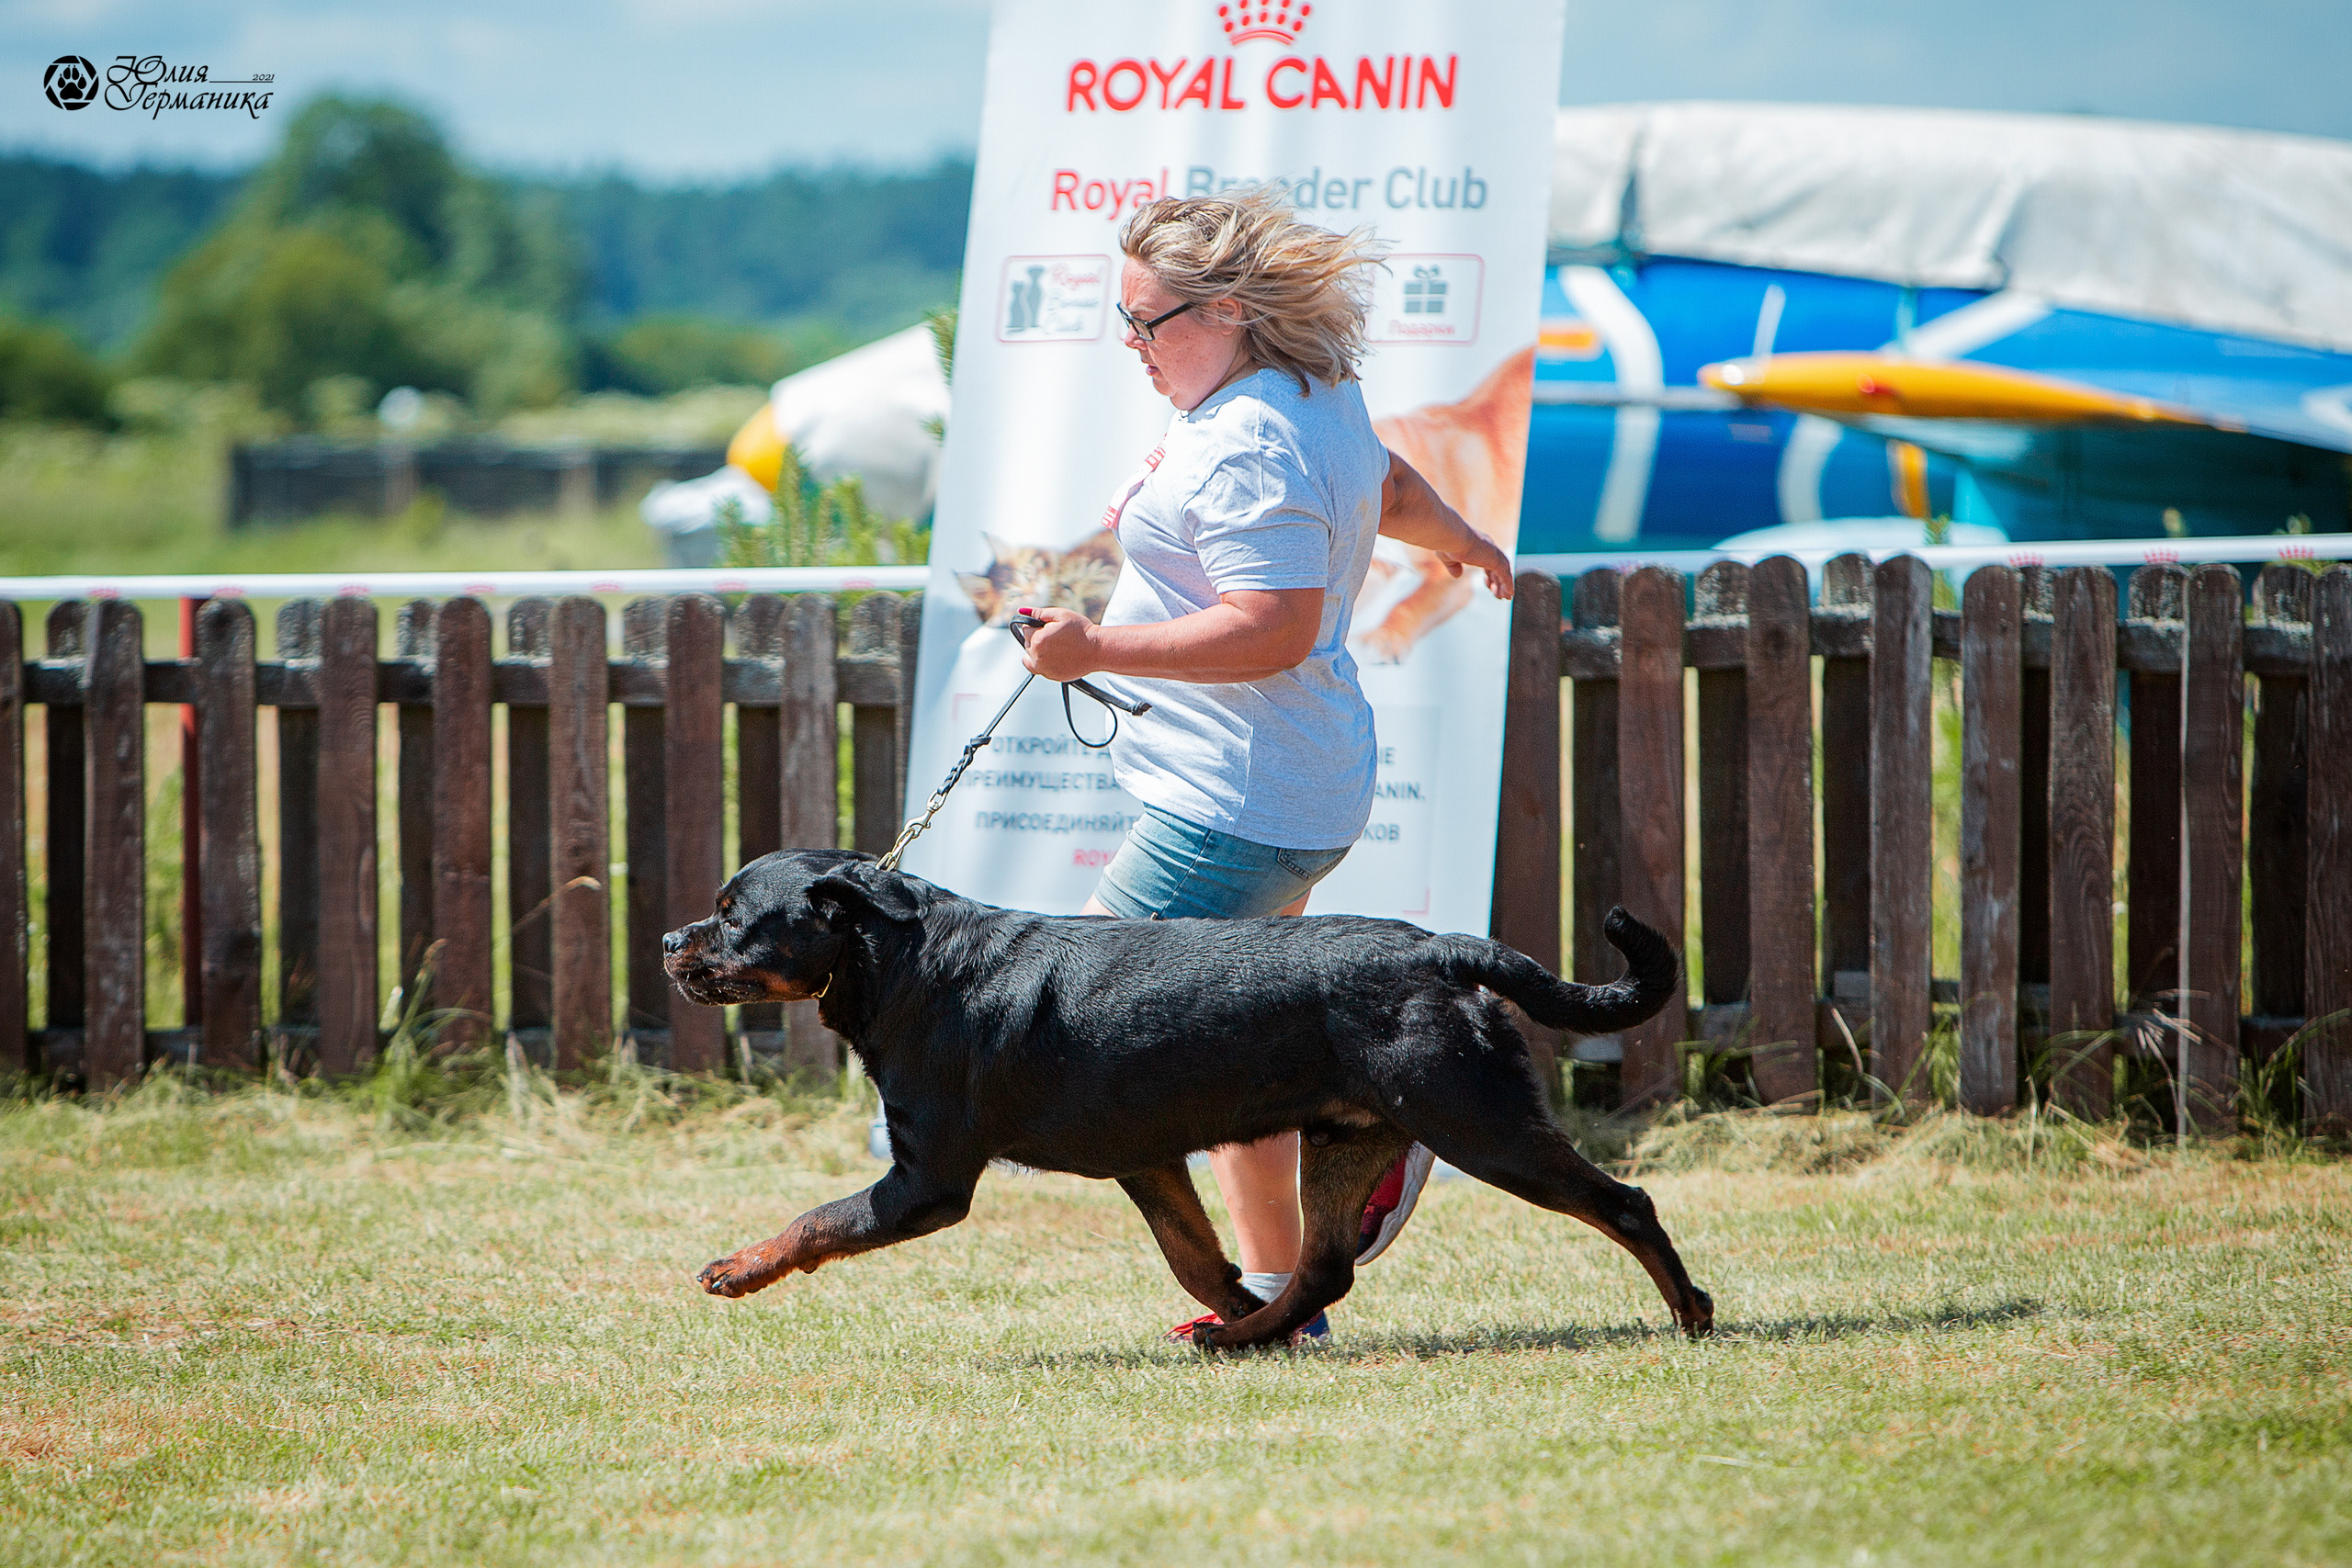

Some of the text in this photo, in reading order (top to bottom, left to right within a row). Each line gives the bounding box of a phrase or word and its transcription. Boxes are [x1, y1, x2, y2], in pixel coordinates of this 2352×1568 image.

[1067, 53, 1458, 112] ROYAL CANIN
[1051, 165, 1488, 220] Royal Bder Club
[1374, 780, 1427, 801] ANIN.
